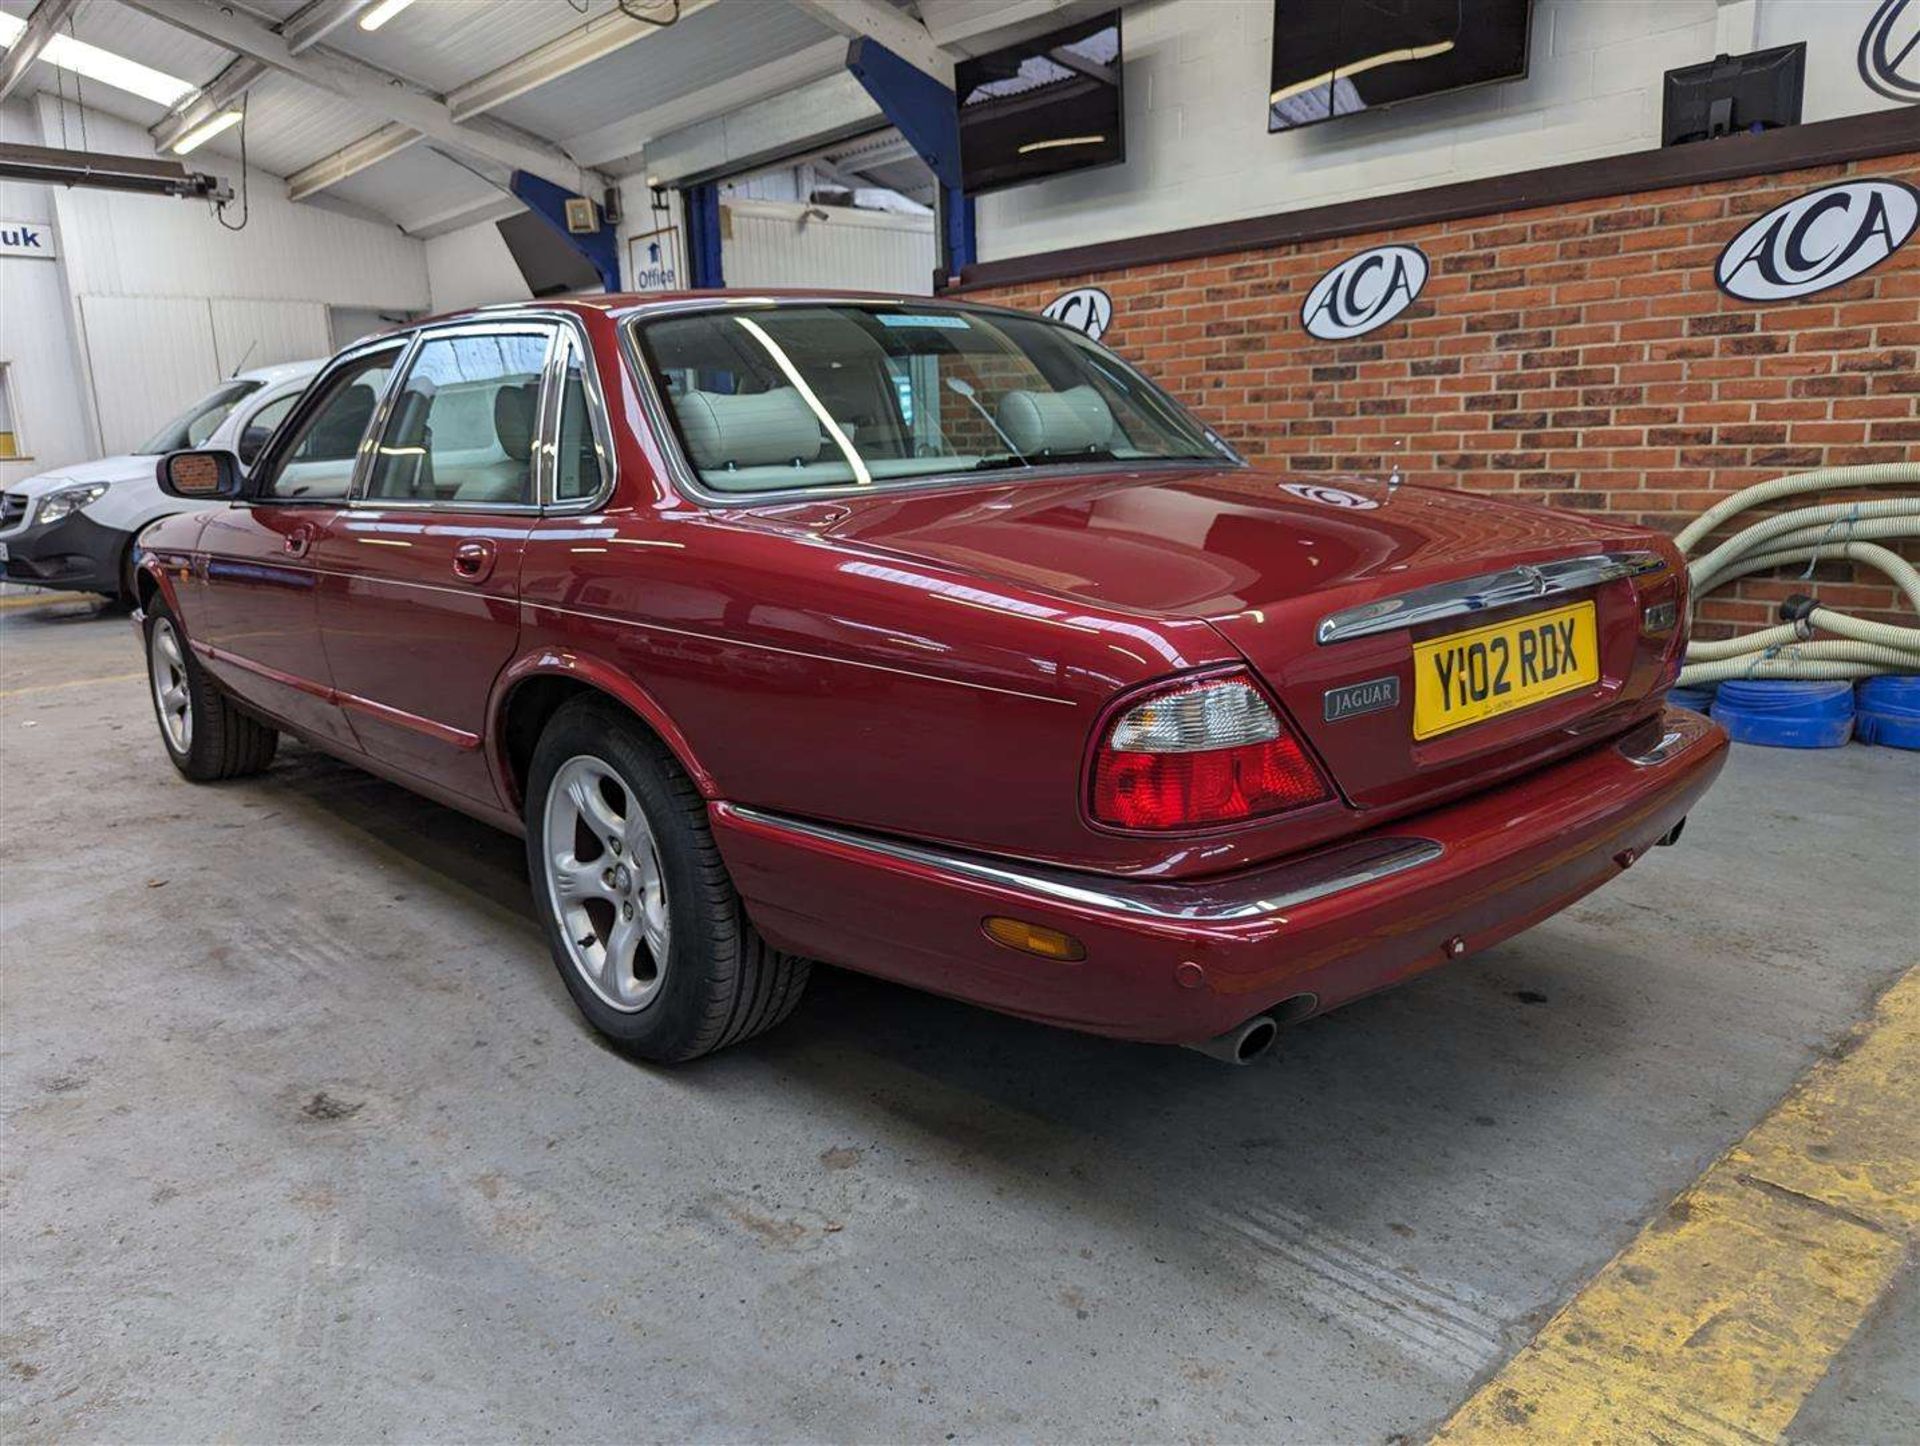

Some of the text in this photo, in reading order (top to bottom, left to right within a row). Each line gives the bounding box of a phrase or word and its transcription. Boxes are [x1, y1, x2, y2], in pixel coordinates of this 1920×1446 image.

[1726, 191, 1894, 286] ACA
[639, 267, 675, 289] Office
[1306, 254, 1412, 328] ACA
[1334, 684, 1392, 716] JAGUAR
[1434, 618, 1578, 712] Y102 RDX
